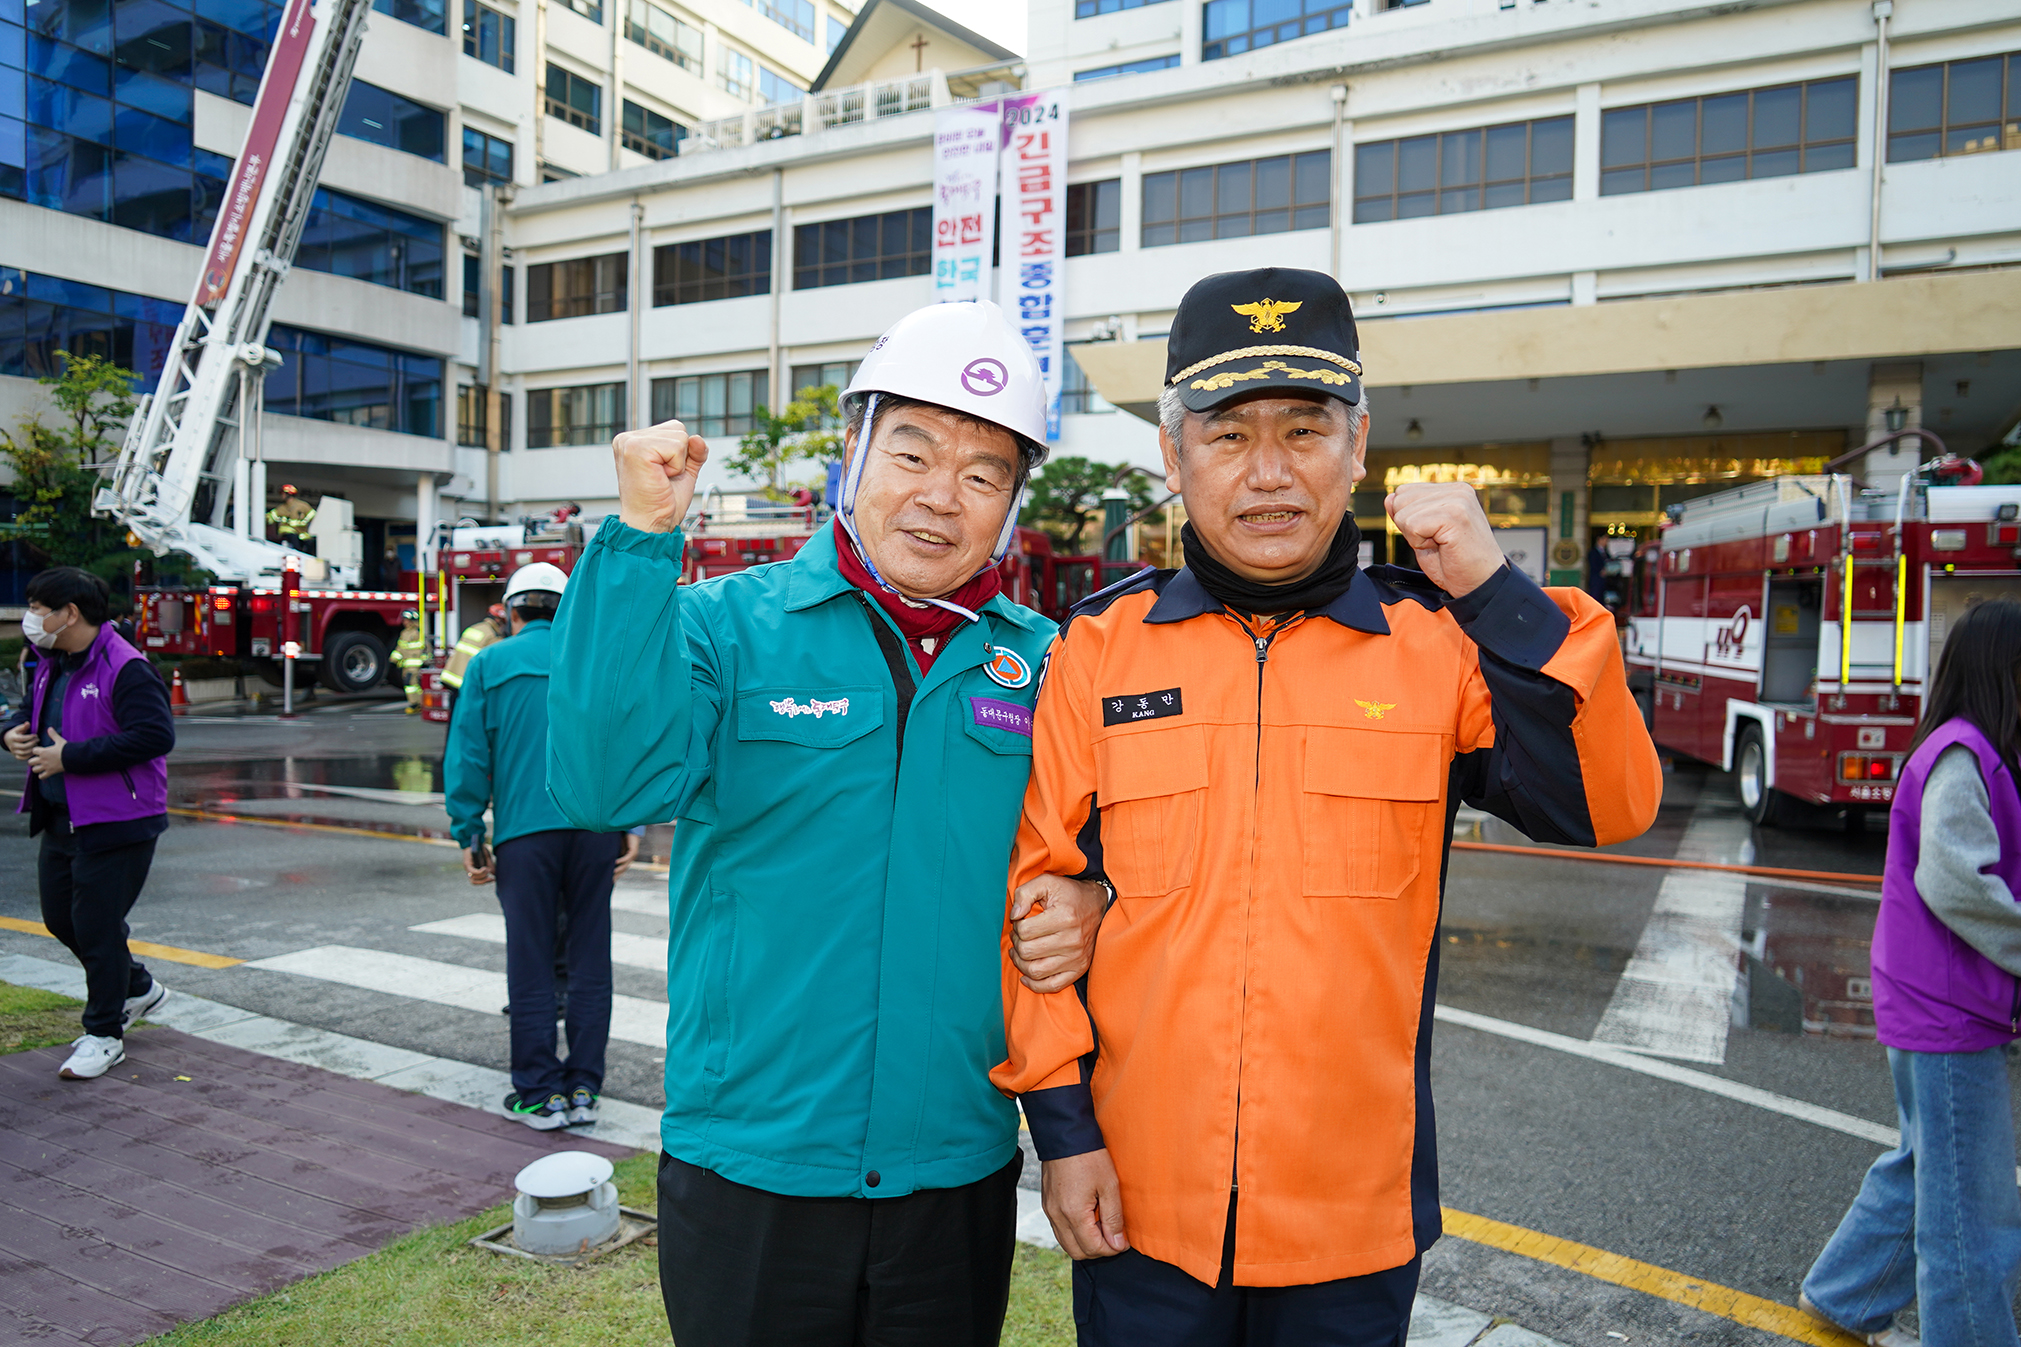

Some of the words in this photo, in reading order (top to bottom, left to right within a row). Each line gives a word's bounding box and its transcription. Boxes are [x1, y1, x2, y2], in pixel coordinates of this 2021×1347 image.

[1006, 104, 1059, 127] 2024
[938, 213, 982, 248] 안전
[936, 256, 980, 289] 한국
[1131, 709, 1155, 718] KANG
